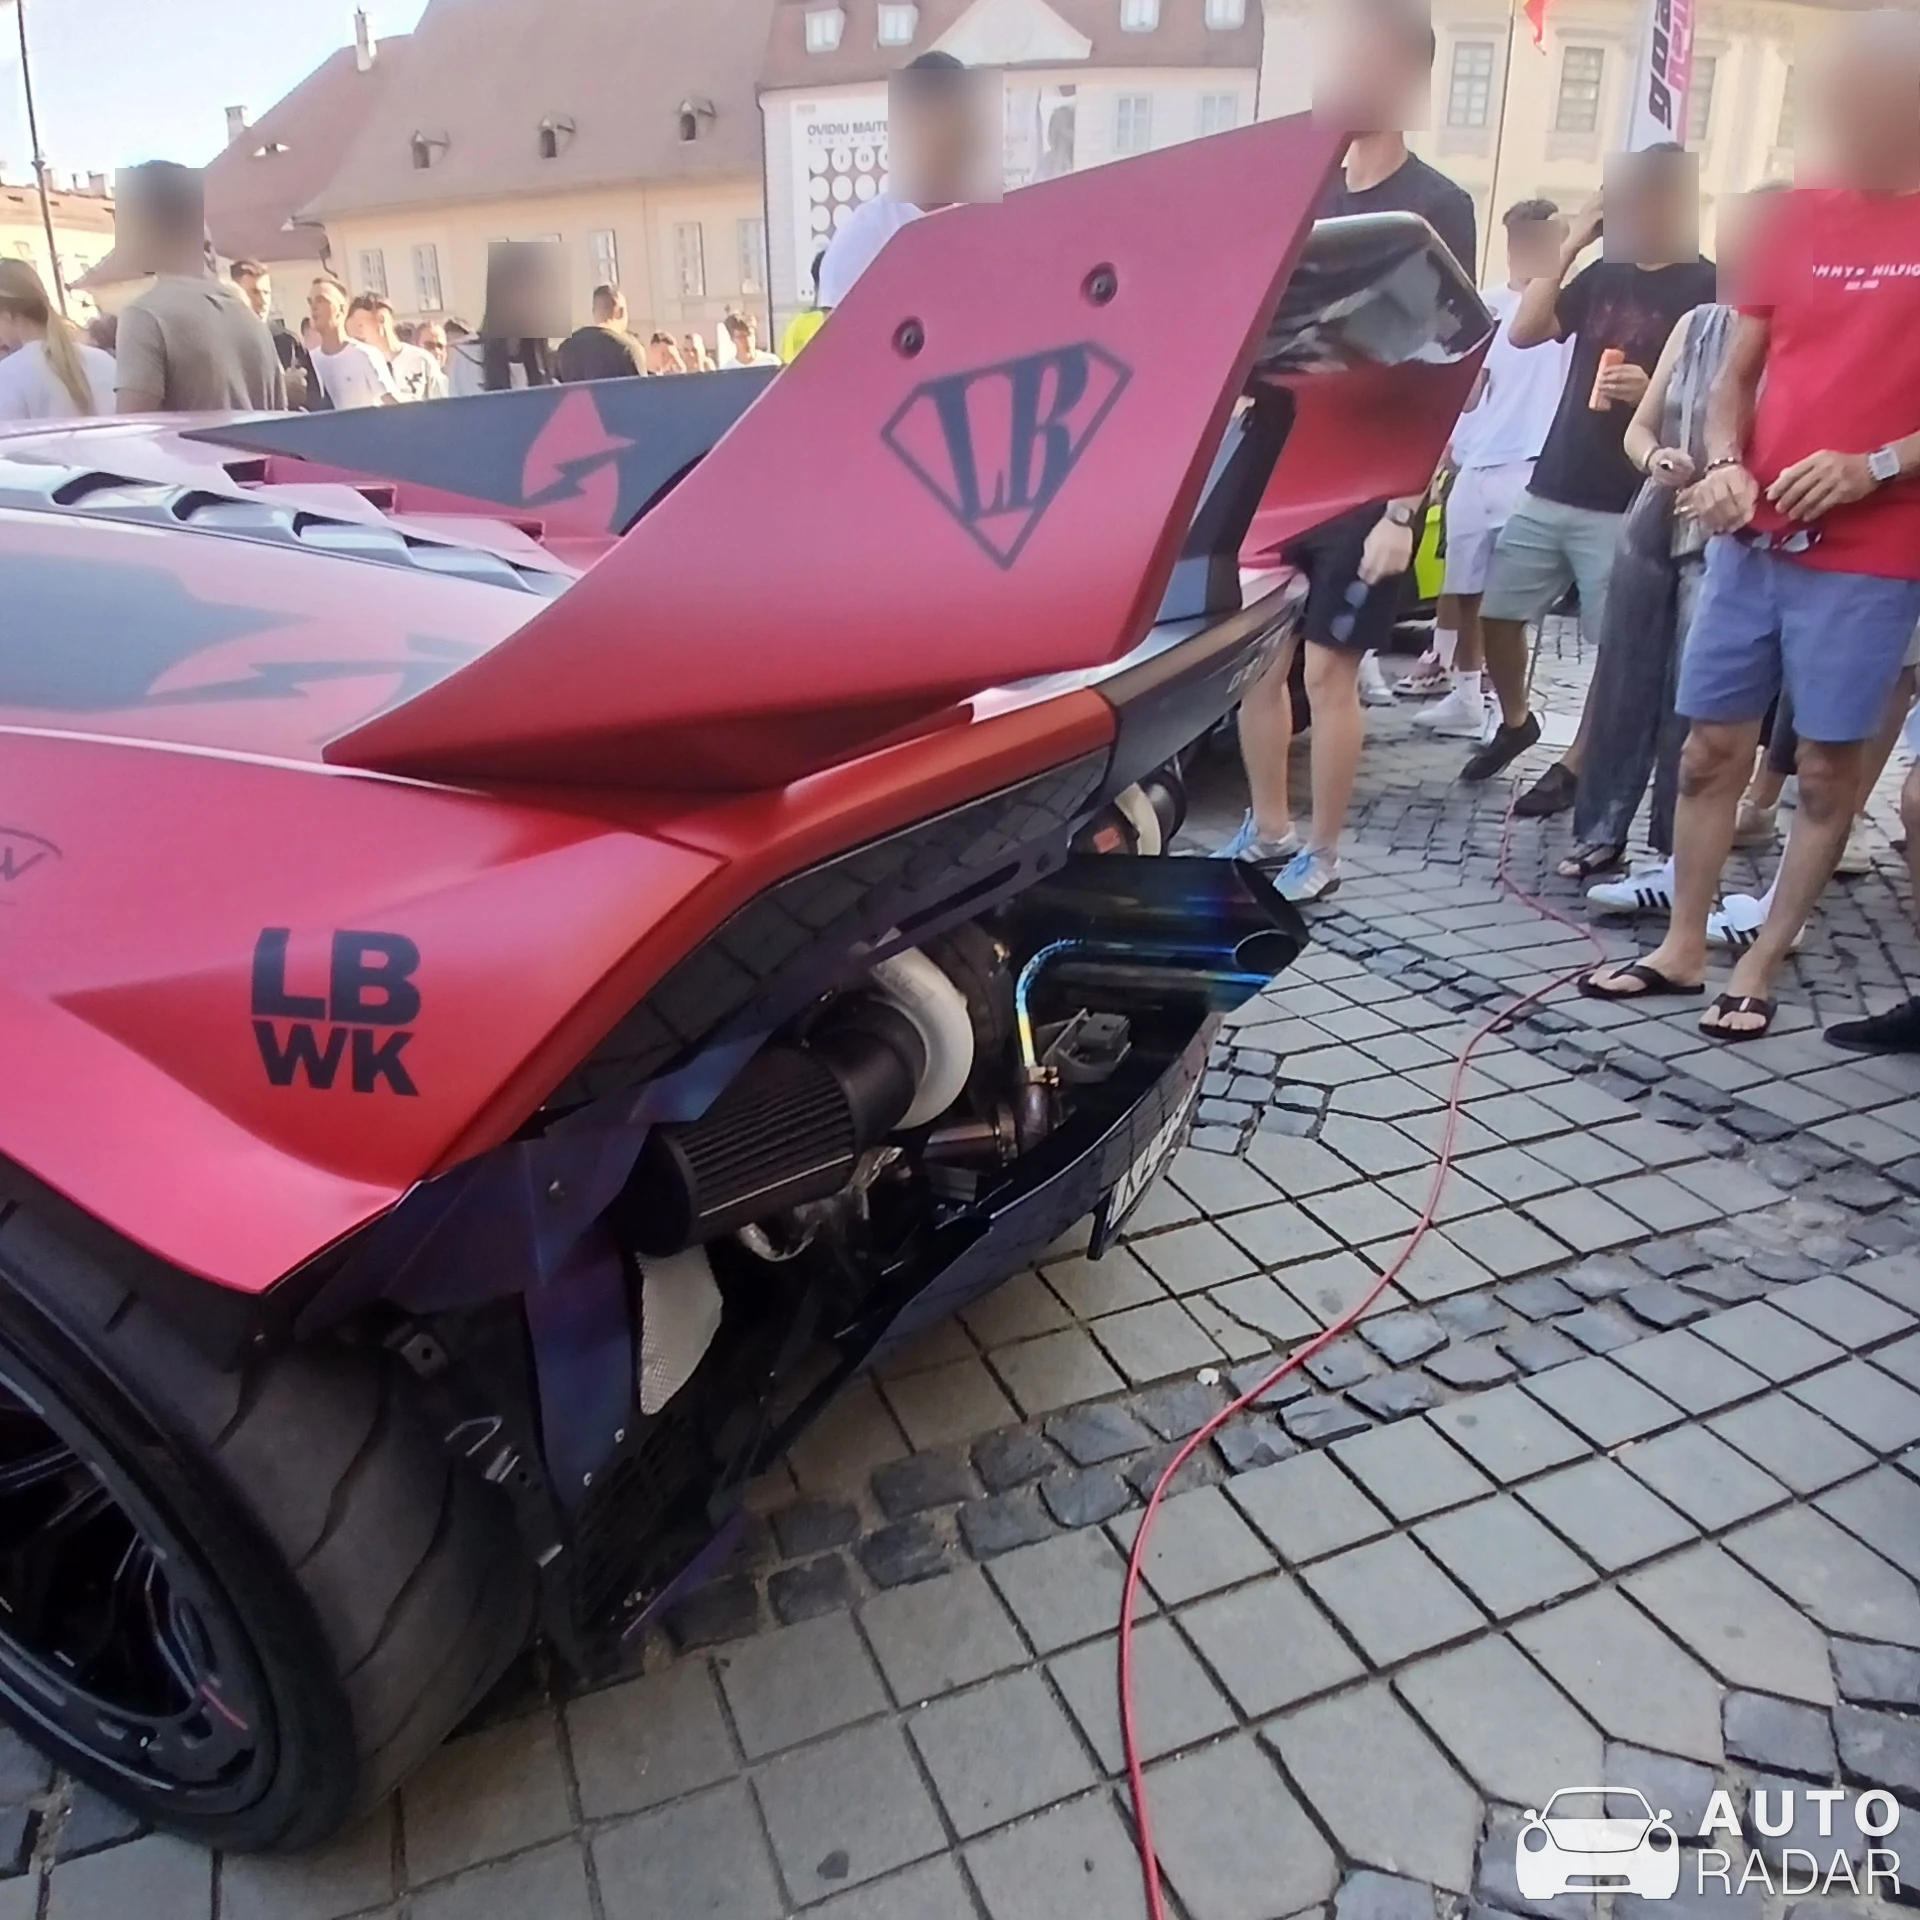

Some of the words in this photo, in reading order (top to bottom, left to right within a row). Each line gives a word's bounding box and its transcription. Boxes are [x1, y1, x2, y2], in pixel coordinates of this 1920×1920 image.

[807, 124, 849, 136] OVIDIU
[1813, 265, 1854, 278] MMY
[251, 927, 421, 1026] LB
[251, 1019, 420, 1097] WK
